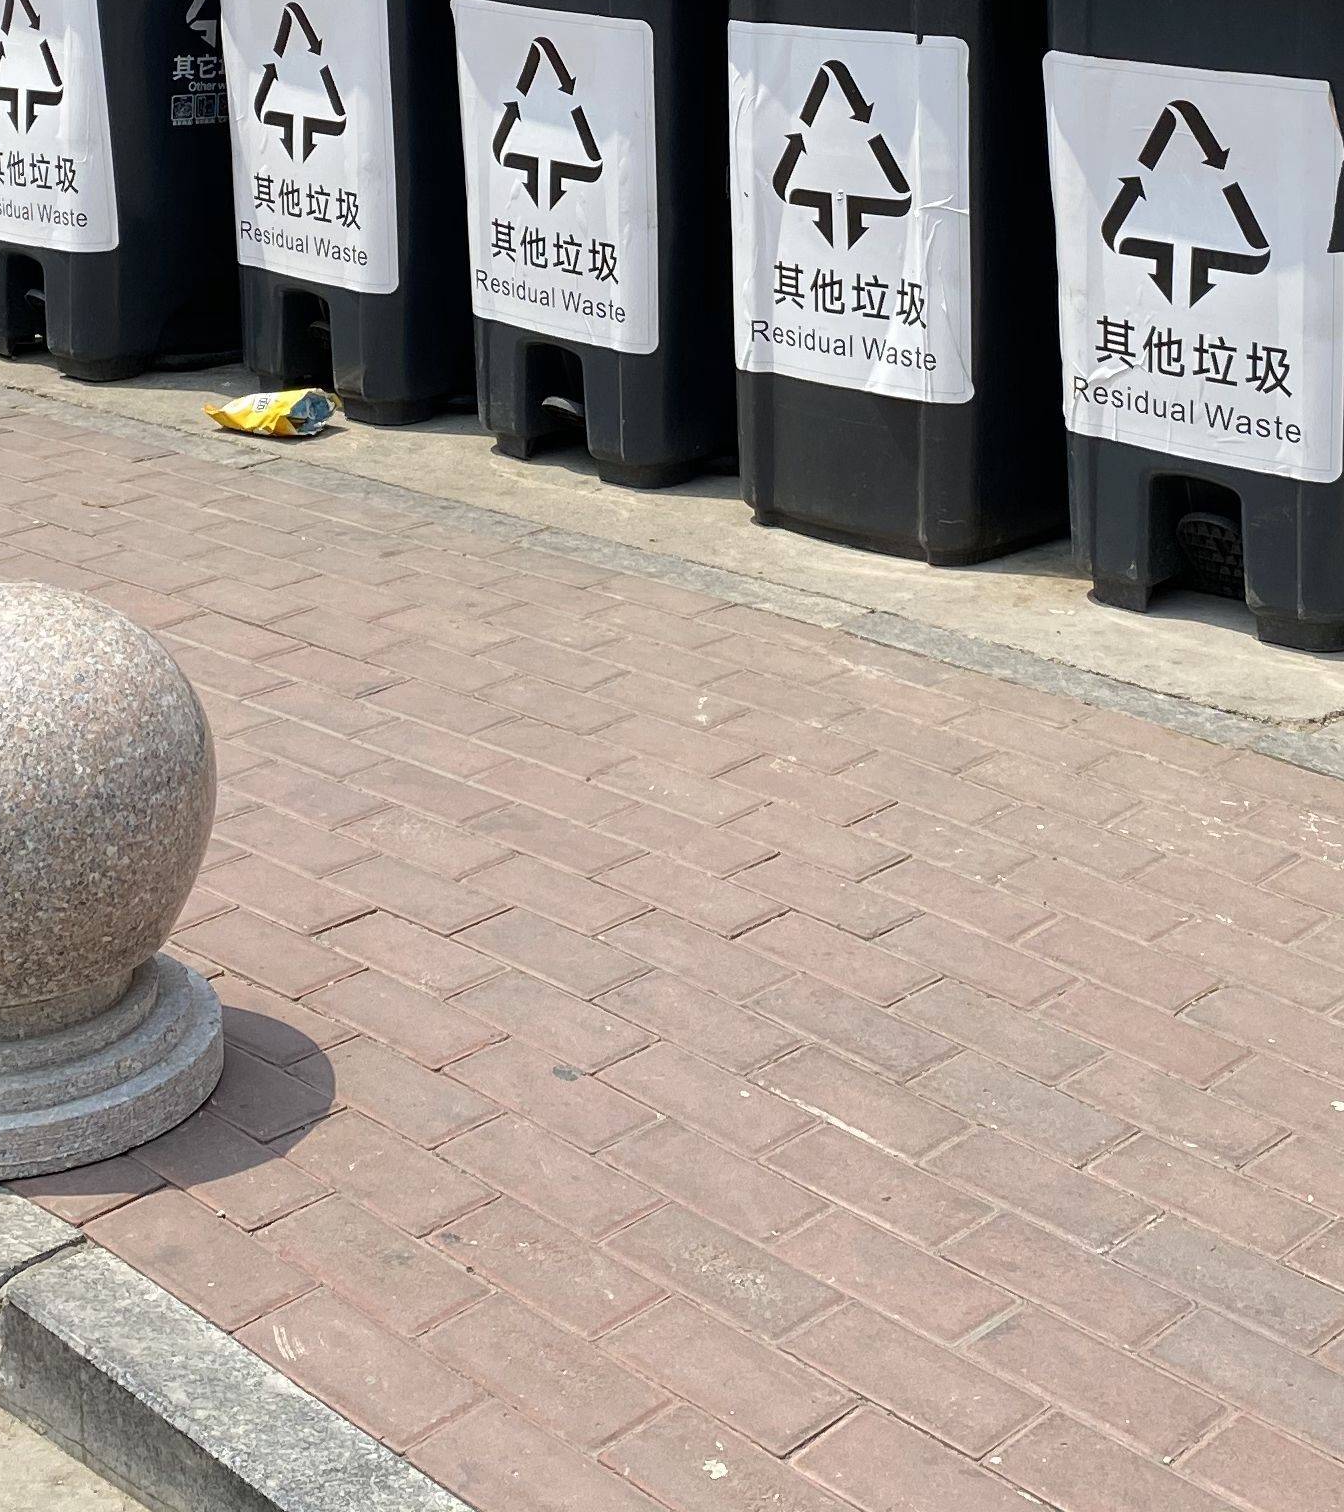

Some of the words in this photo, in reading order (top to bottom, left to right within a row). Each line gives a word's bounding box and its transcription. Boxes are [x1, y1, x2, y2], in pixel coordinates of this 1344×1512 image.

[188, 81, 216, 92] Other
[37, 202, 88, 229] Waste
[252, 172, 362, 232] 其他垃圾
[240, 220, 311, 256] Residual
[314, 237, 369, 267] Waste
[490, 217, 620, 286] 其他垃圾
[475, 268, 556, 309] Residual
[561, 288, 627, 325] Waste
[772, 261, 928, 331] 其他垃圾
[750, 318, 854, 360] Residual
[861, 334, 938, 373] Waste
[1094, 314, 1294, 399] 其他垃圾
[1071, 374, 1196, 426] Residual
[1203, 402, 1303, 445] Waste
